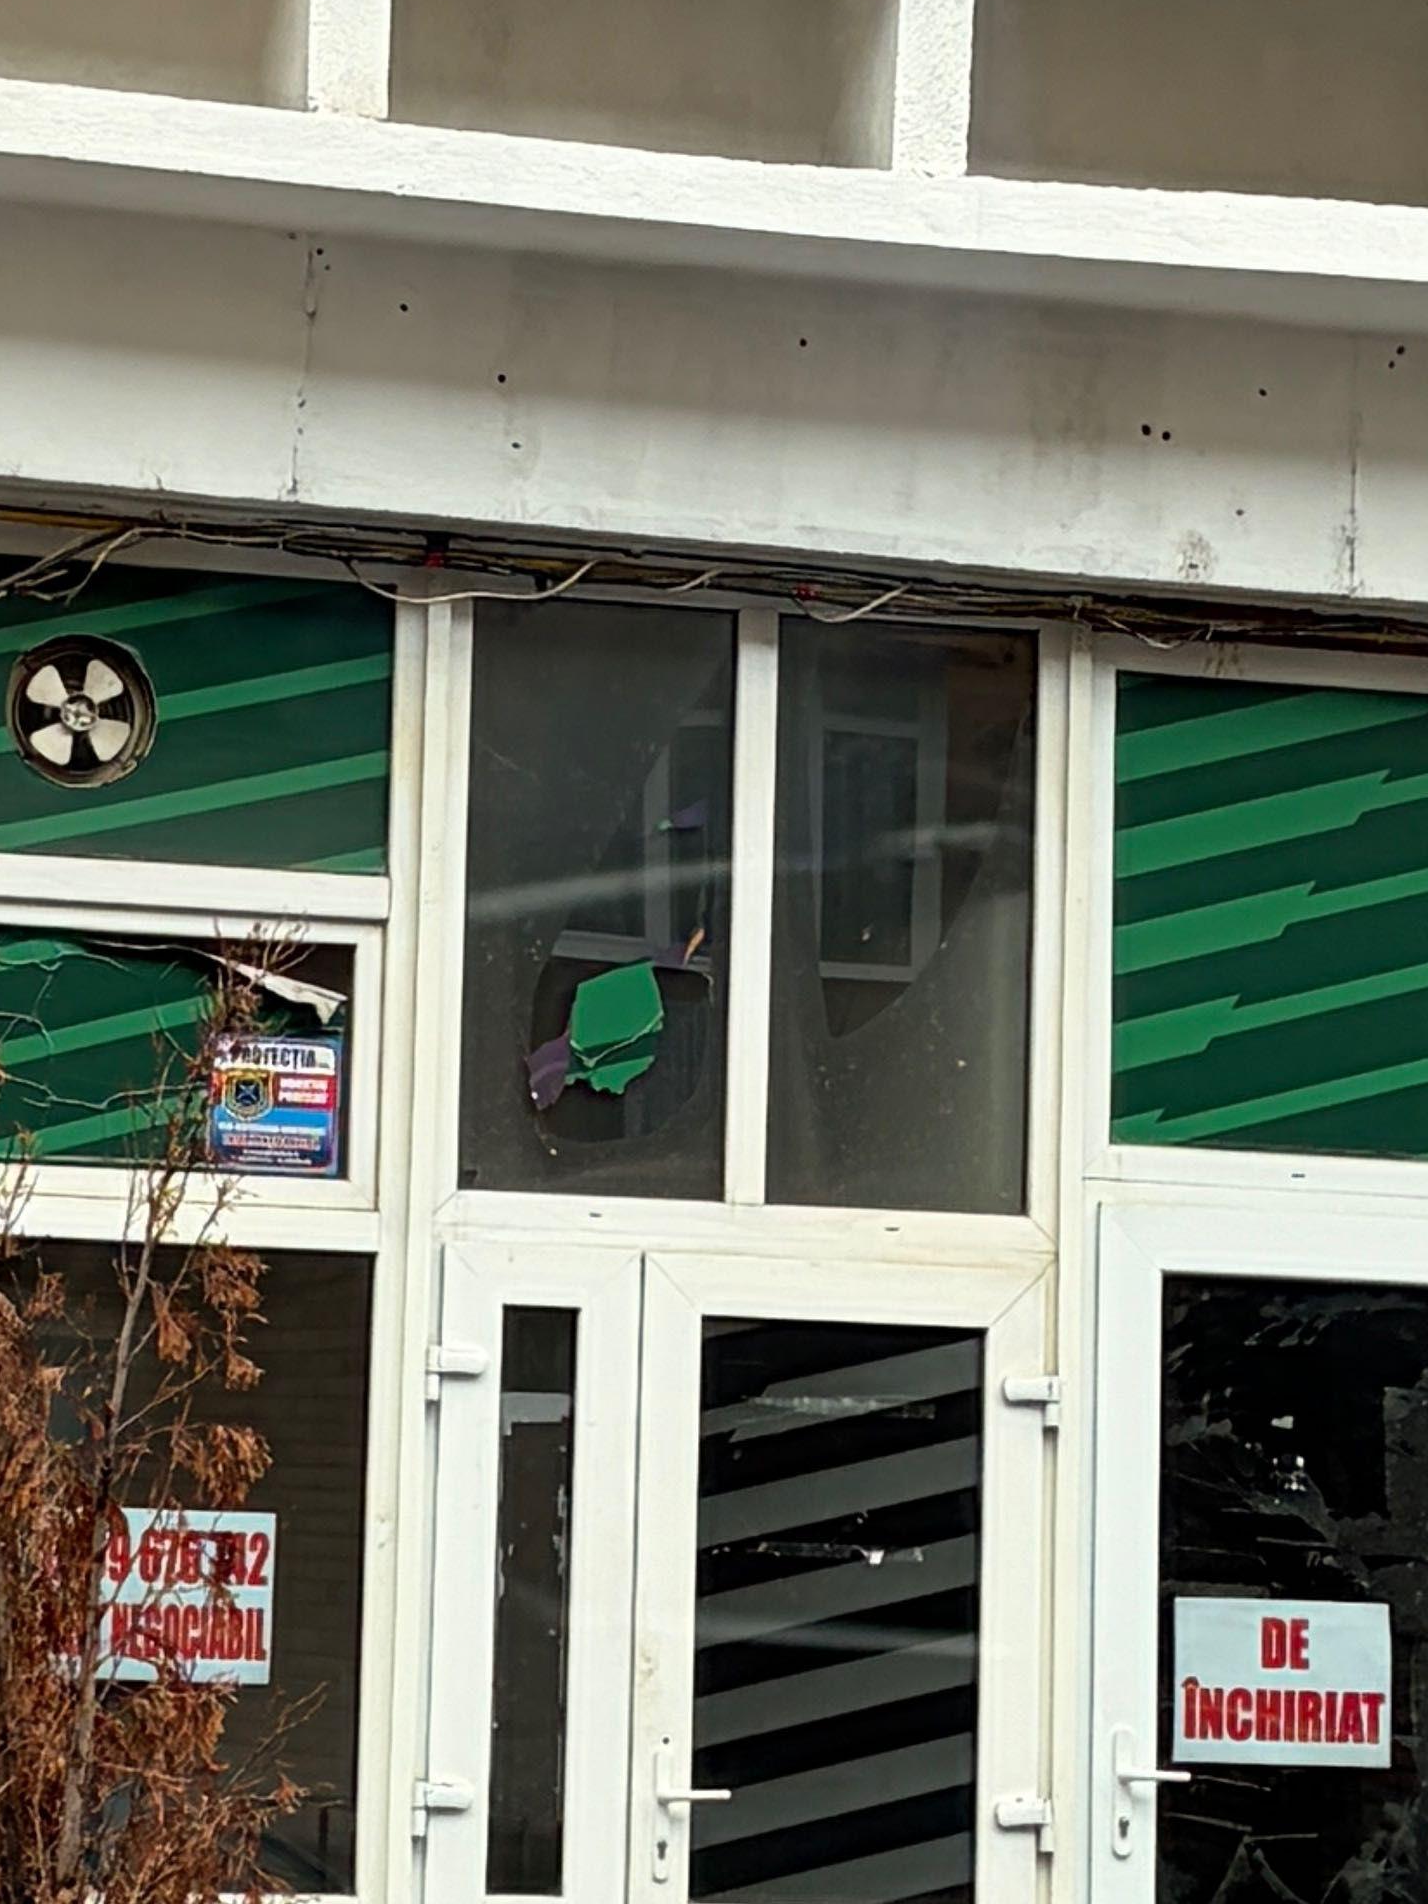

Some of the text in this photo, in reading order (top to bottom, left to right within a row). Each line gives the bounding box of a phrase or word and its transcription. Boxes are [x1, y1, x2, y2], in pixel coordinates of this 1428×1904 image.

[109, 1602, 267, 1661] NEGOCIABIL
[1261, 1616, 1310, 1670] DE
[1181, 1676, 1386, 1745] ÎNCHIRIAT
